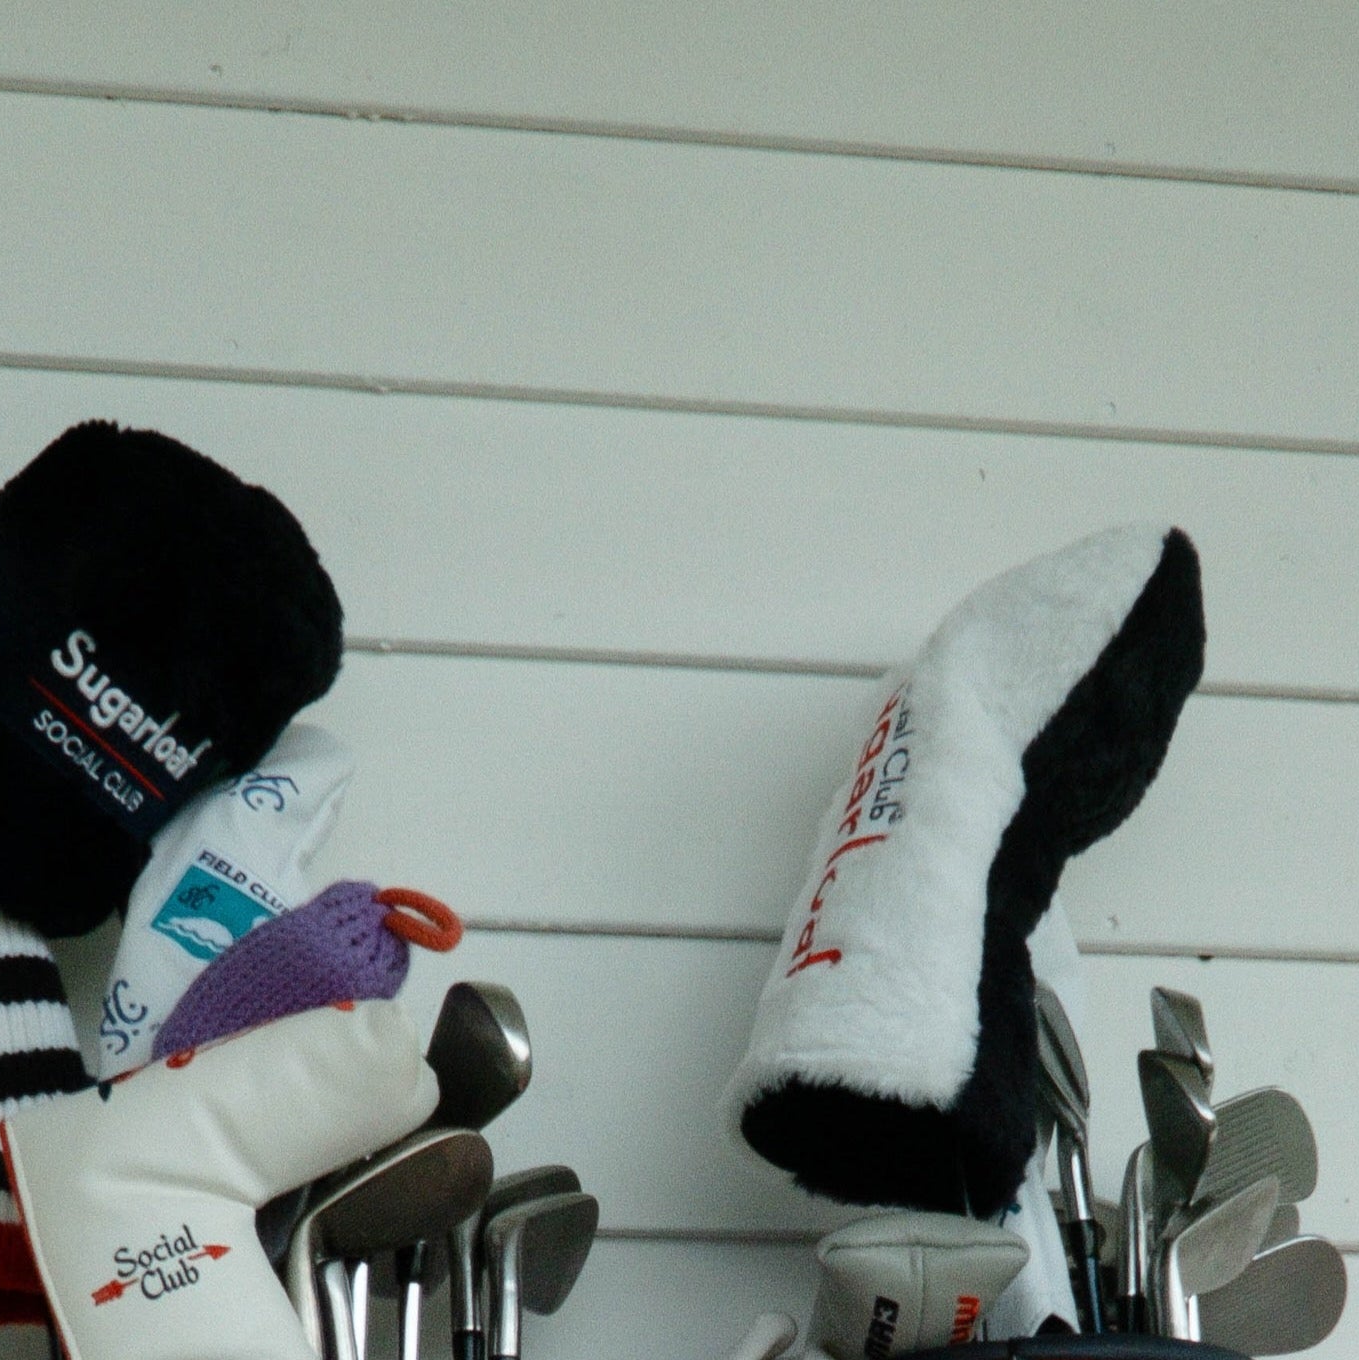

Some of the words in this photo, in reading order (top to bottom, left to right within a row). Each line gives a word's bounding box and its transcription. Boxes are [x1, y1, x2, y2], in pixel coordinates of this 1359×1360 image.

[50, 628, 213, 782] Sugarloaf
[32, 708, 104, 782] SOCIAL
[198, 849, 248, 885] FIELD
[113, 1222, 200, 1278] Social
[140, 1258, 200, 1301] Club
